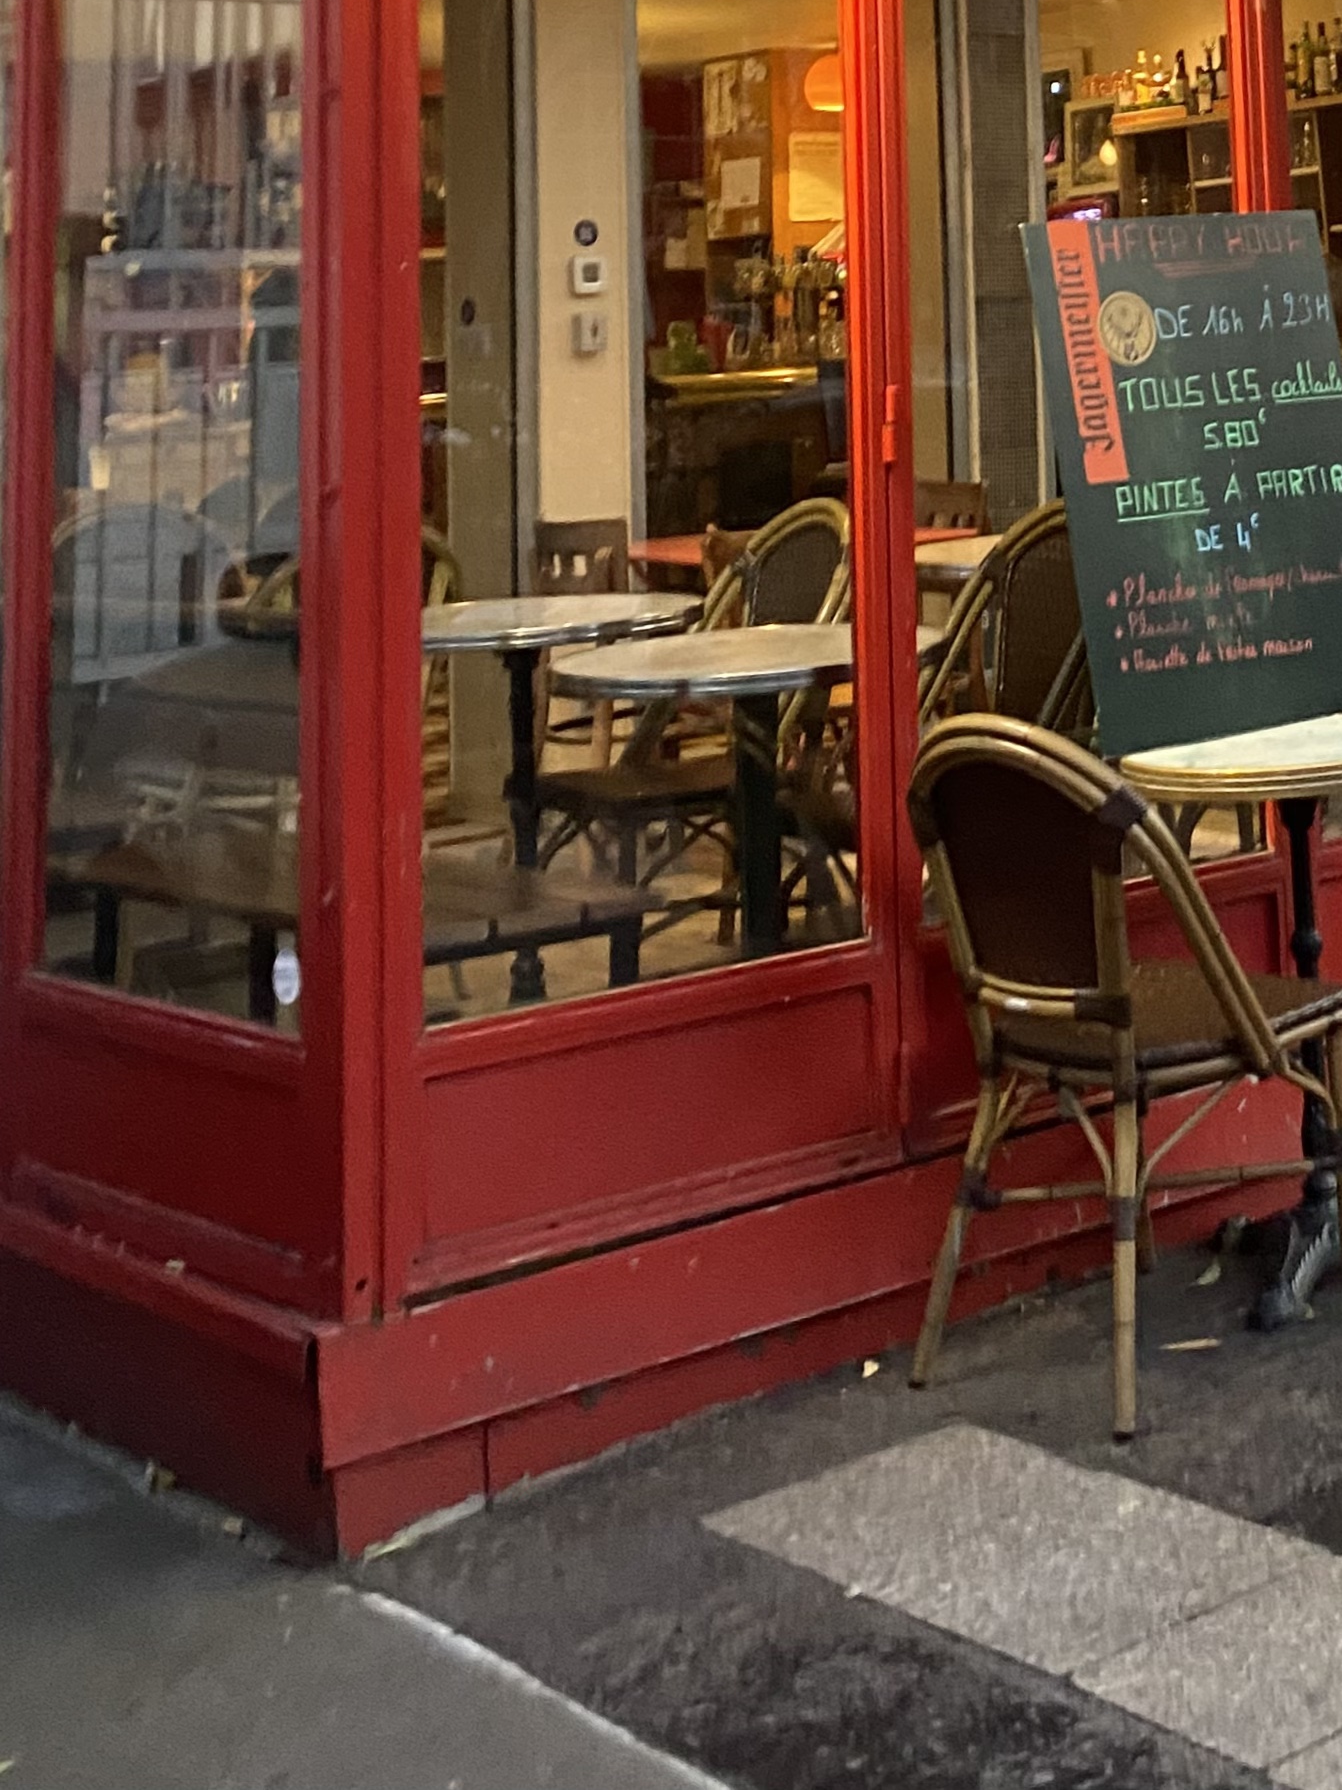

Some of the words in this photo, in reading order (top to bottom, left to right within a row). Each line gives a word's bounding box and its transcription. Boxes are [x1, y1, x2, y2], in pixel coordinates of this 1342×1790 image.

[1154, 304, 1193, 339] DE
[1202, 305, 1244, 335] 16h
[1118, 375, 1205, 412] TOUS
[1211, 368, 1262, 405] LES
[1115, 477, 1206, 516] PINTES
[1195, 524, 1224, 552] DE
